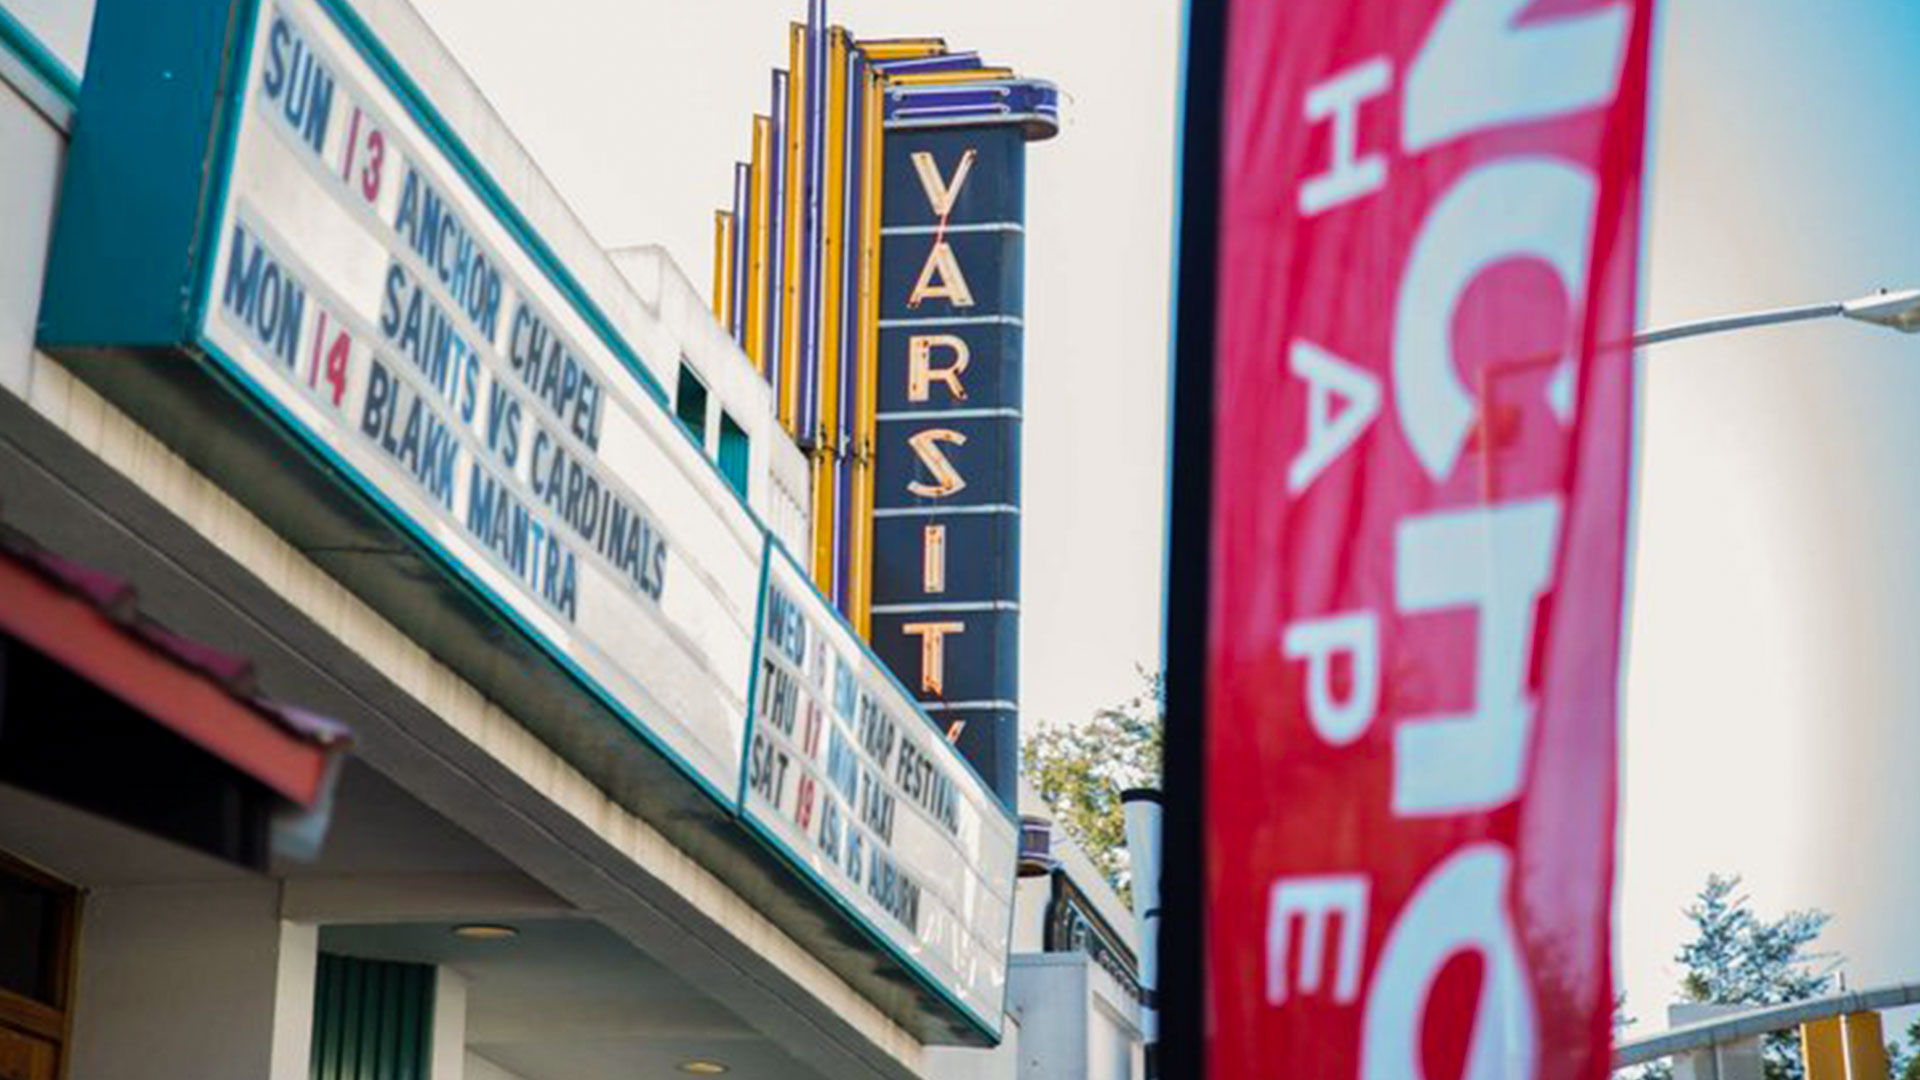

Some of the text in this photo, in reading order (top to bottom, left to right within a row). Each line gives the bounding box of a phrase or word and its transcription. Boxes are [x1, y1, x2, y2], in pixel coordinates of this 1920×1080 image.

[264, 18, 600, 451] SUN 13 ANCHOR CHAPEL
[223, 225, 578, 622] MON 14 BLAKK MANTRA
[382, 264, 667, 601] SAINTS VS CARDINALS
[903, 149, 977, 746] VARSIT
[750, 733, 789, 810] SAT
[763, 657, 799, 736] THU
[768, 584, 806, 667] WED
[896, 738, 959, 836] FESTIVAL
